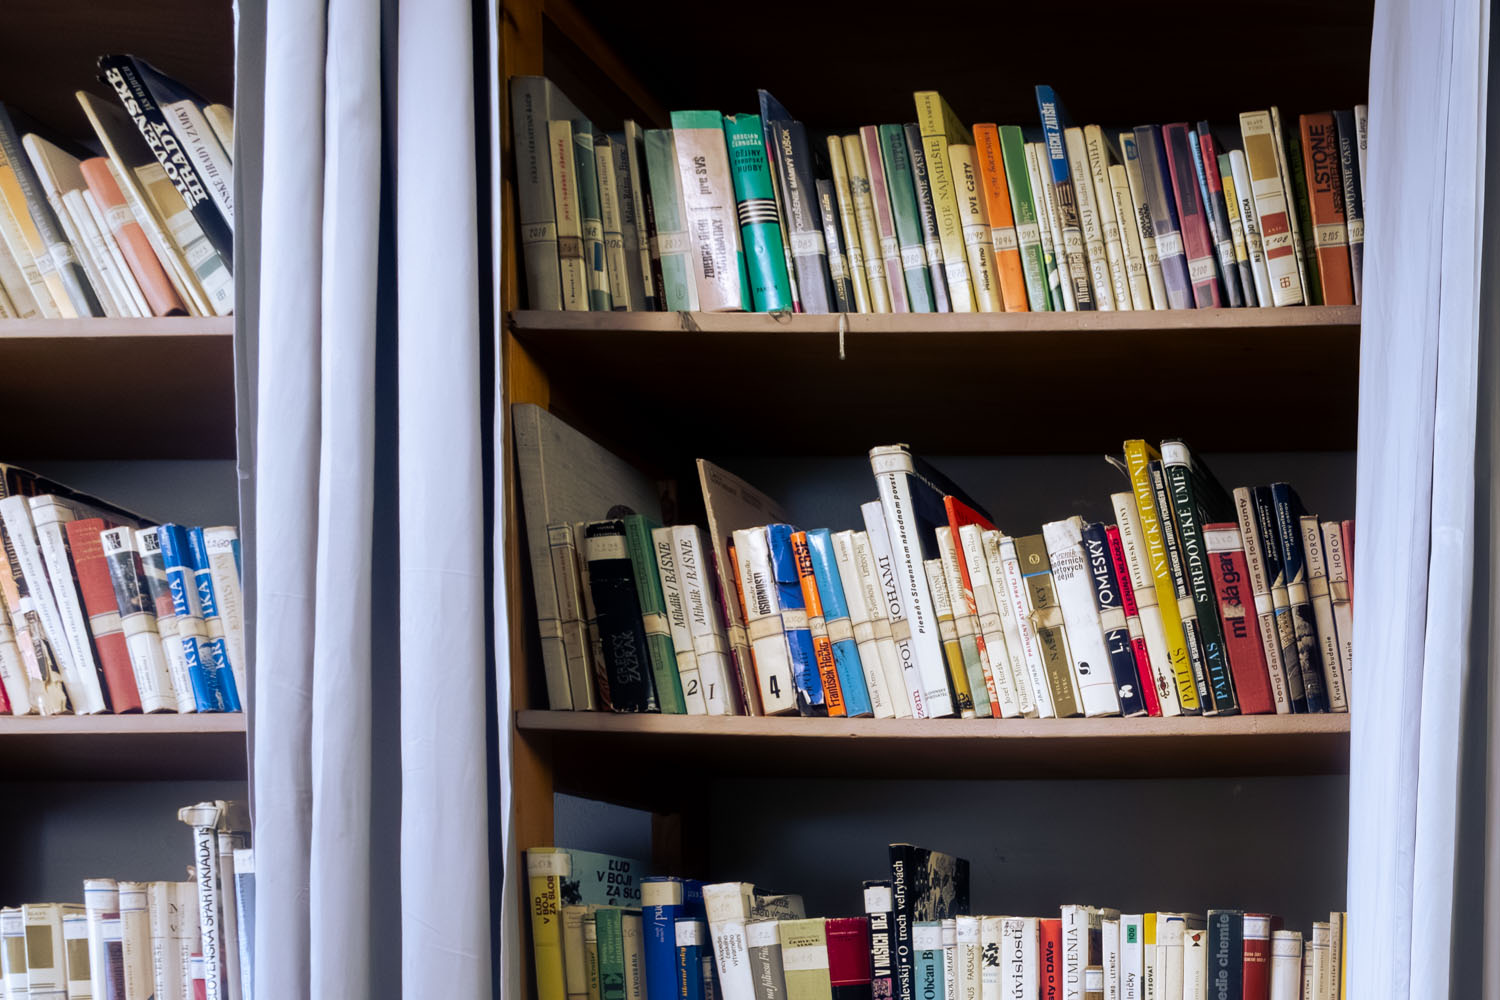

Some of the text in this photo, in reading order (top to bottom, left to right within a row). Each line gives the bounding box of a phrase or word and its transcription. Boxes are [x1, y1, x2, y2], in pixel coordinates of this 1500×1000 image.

[153, 120, 208, 201] HRADY
[780, 130, 804, 231] POKUŠENIE MÁMIVÝ DÚŠOK
[929, 140, 955, 235] MOJE NAJMILŠIE
[969, 196, 978, 214] DVE
[1238, 498, 1259, 570] na lodi bounty
[1306, 527, 1319, 562] HOROV
[1330, 533, 1341, 568] HOROV
[793, 541, 813, 578] VERŠE
[1131, 447, 1194, 702] PALLAS ANTICKÉ UMENIE
[659, 542, 685, 628] Mihálik BÁSNE
[681, 540, 705, 625] Mihálik BÁSNE
[1171, 465, 1227, 699] PALLAS STREDOVEKÉ UMEN
[1263, 616, 1284, 703] bengt danielsson
[687, 680, 697, 695] 2
[708, 683, 715, 699] 1
[769, 675, 780, 697] 4
[897, 915, 906, 940] troch
[1217, 914, 1230, 966] chemie
[872, 933, 889, 966] NAŠICH
[899, 946, 908, 955] O
[876, 968, 890, 977] V
[922, 965, 935, 1000] Občan
